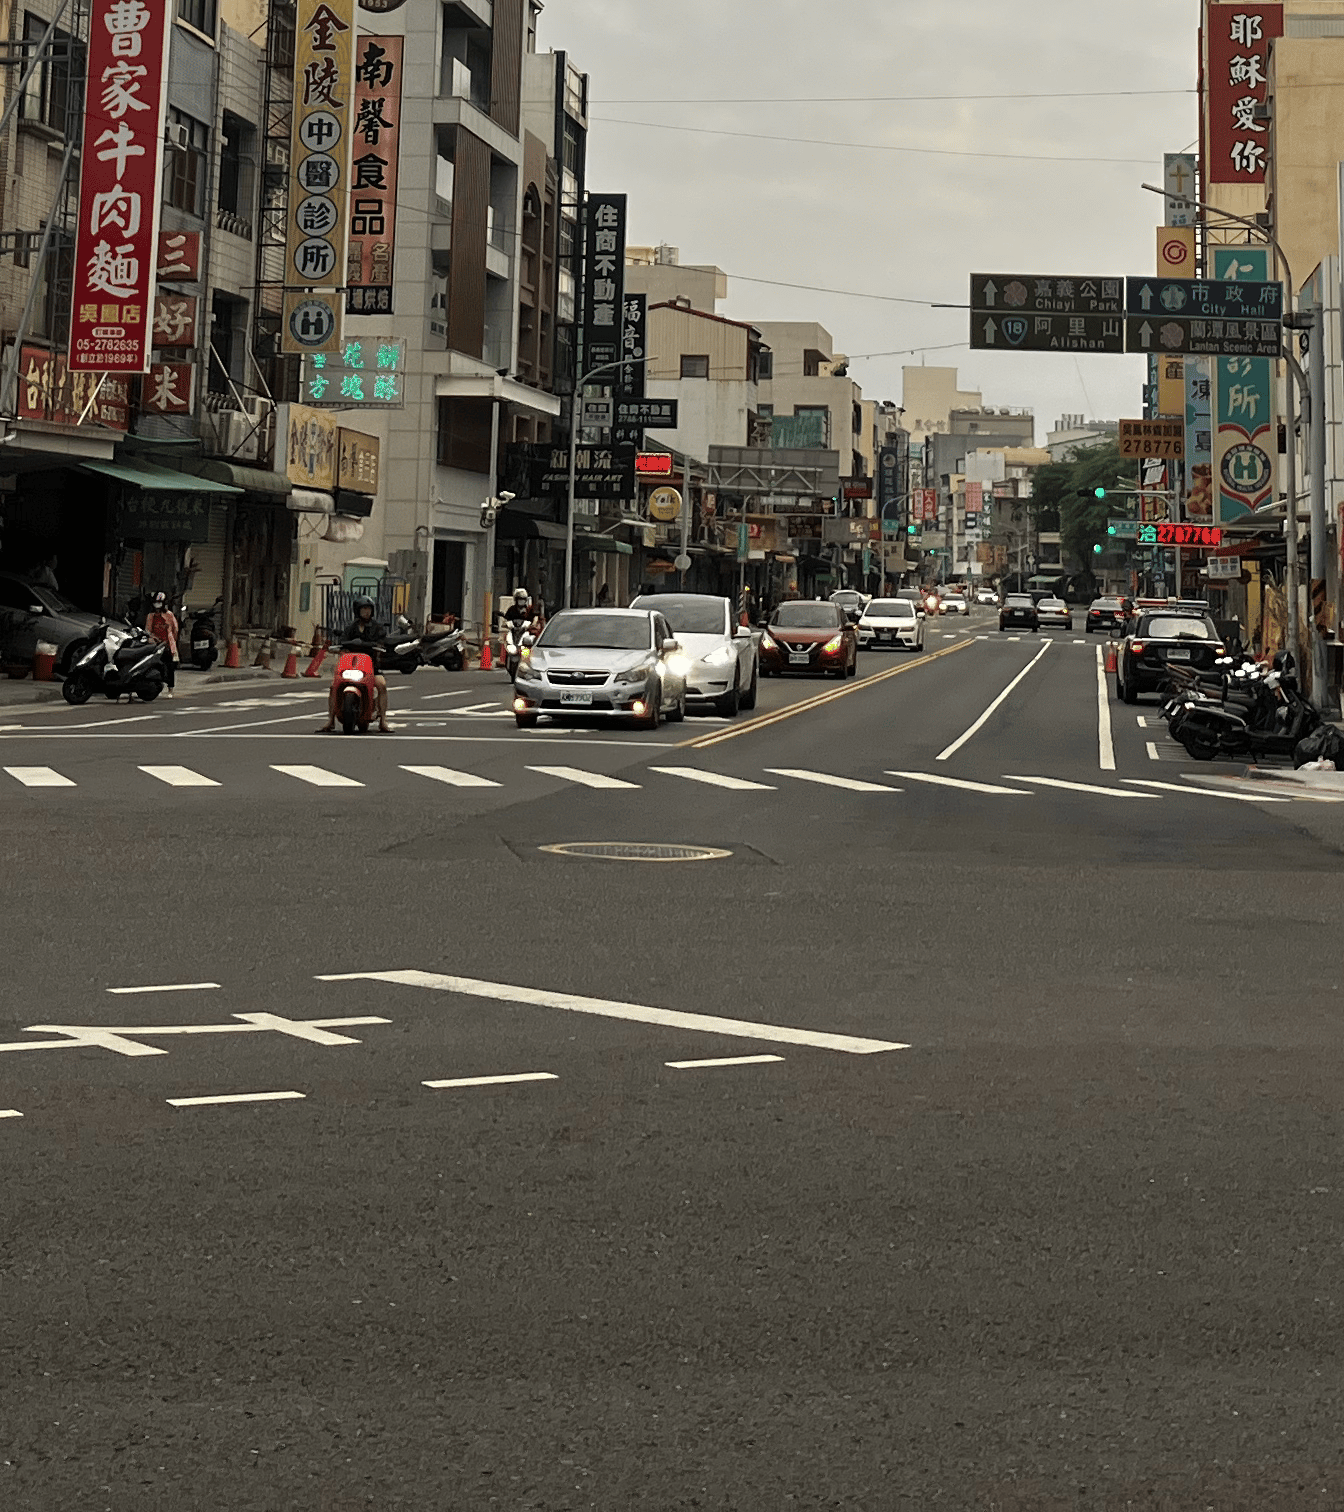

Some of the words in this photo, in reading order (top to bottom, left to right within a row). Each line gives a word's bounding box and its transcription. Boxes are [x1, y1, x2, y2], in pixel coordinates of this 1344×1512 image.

[1229, 12, 1267, 175] 耶穌愛你
[300, 3, 349, 275] 金陵中醫診所
[351, 41, 394, 236] 南馨食品
[86, 0, 151, 299] 曹家牛肉麵
[592, 203, 619, 327] 住商不動產
[1034, 279, 1119, 300] 嘉義公園
[1191, 283, 1279, 304] 市政府
[1035, 298, 1075, 311] Chiayi
[1089, 300, 1118, 312] Park
[1201, 303, 1226, 317] City
[1241, 304, 1265, 316] Hall
[1007, 322, 1022, 335] 18
[1034, 316, 1119, 337] 阿里山
[1189, 320, 1278, 342] 蘭潭風景區
[76, 338, 140, 351] 05-2782635
[1050, 336, 1105, 349] Alishan
[1189, 340, 1219, 352] Lantan
[1223, 341, 1253, 353] Scenic
[1256, 342, 1278, 354] Area
